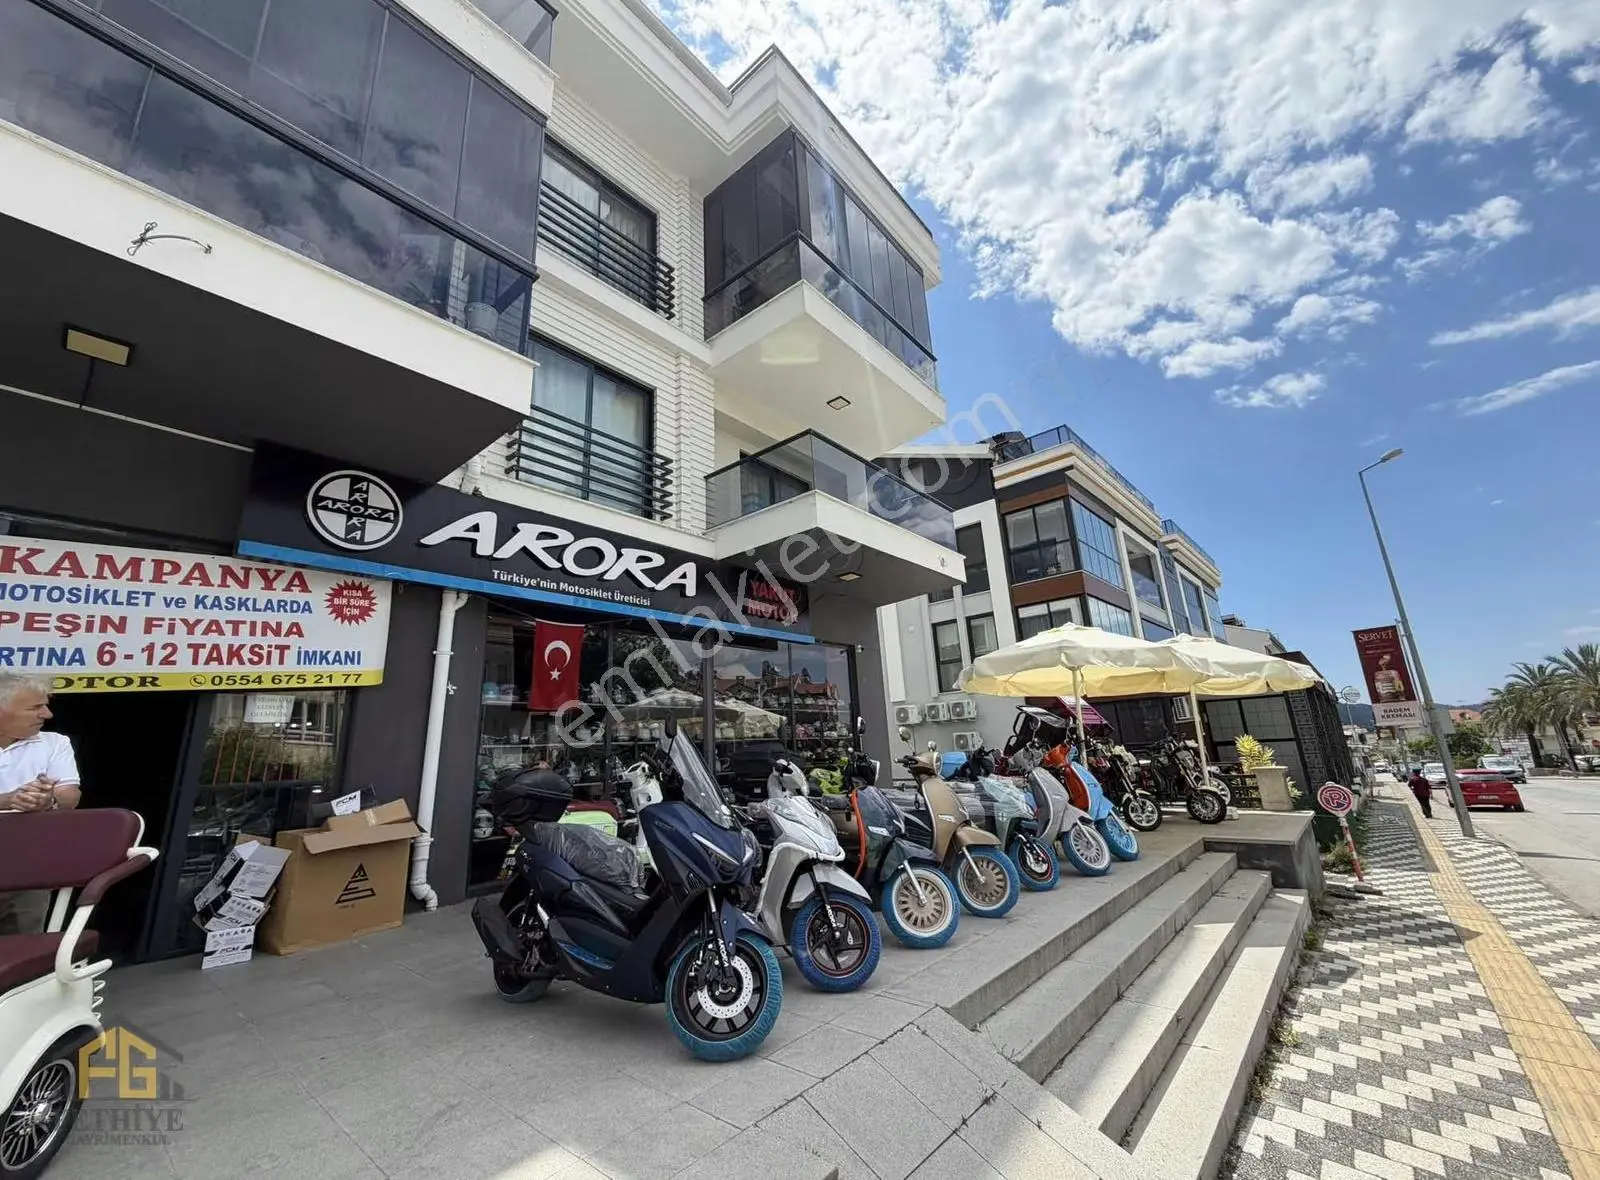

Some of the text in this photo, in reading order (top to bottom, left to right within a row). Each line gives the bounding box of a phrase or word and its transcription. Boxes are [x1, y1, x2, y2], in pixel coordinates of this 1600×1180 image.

[317, 500, 395, 520] ARORA
[419, 511, 697, 597] ARORA
[0, 545, 312, 593] KAMPANYA
[343, 589, 362, 597] KISA
[492, 569, 651, 606] Türkiye'nin Motosiklet Üreticisi
[163, 596, 187, 609] ve
[194, 594, 313, 614] KASKLARDA
[333, 597, 370, 607] BİR SÜRE
[343, 607, 360, 616] İÇİN
[1358, 630, 1393, 642] SERVET
[296, 646, 361, 665] İMKANI
[51, 673, 362, 689] OTOR 0554 675 21 77
